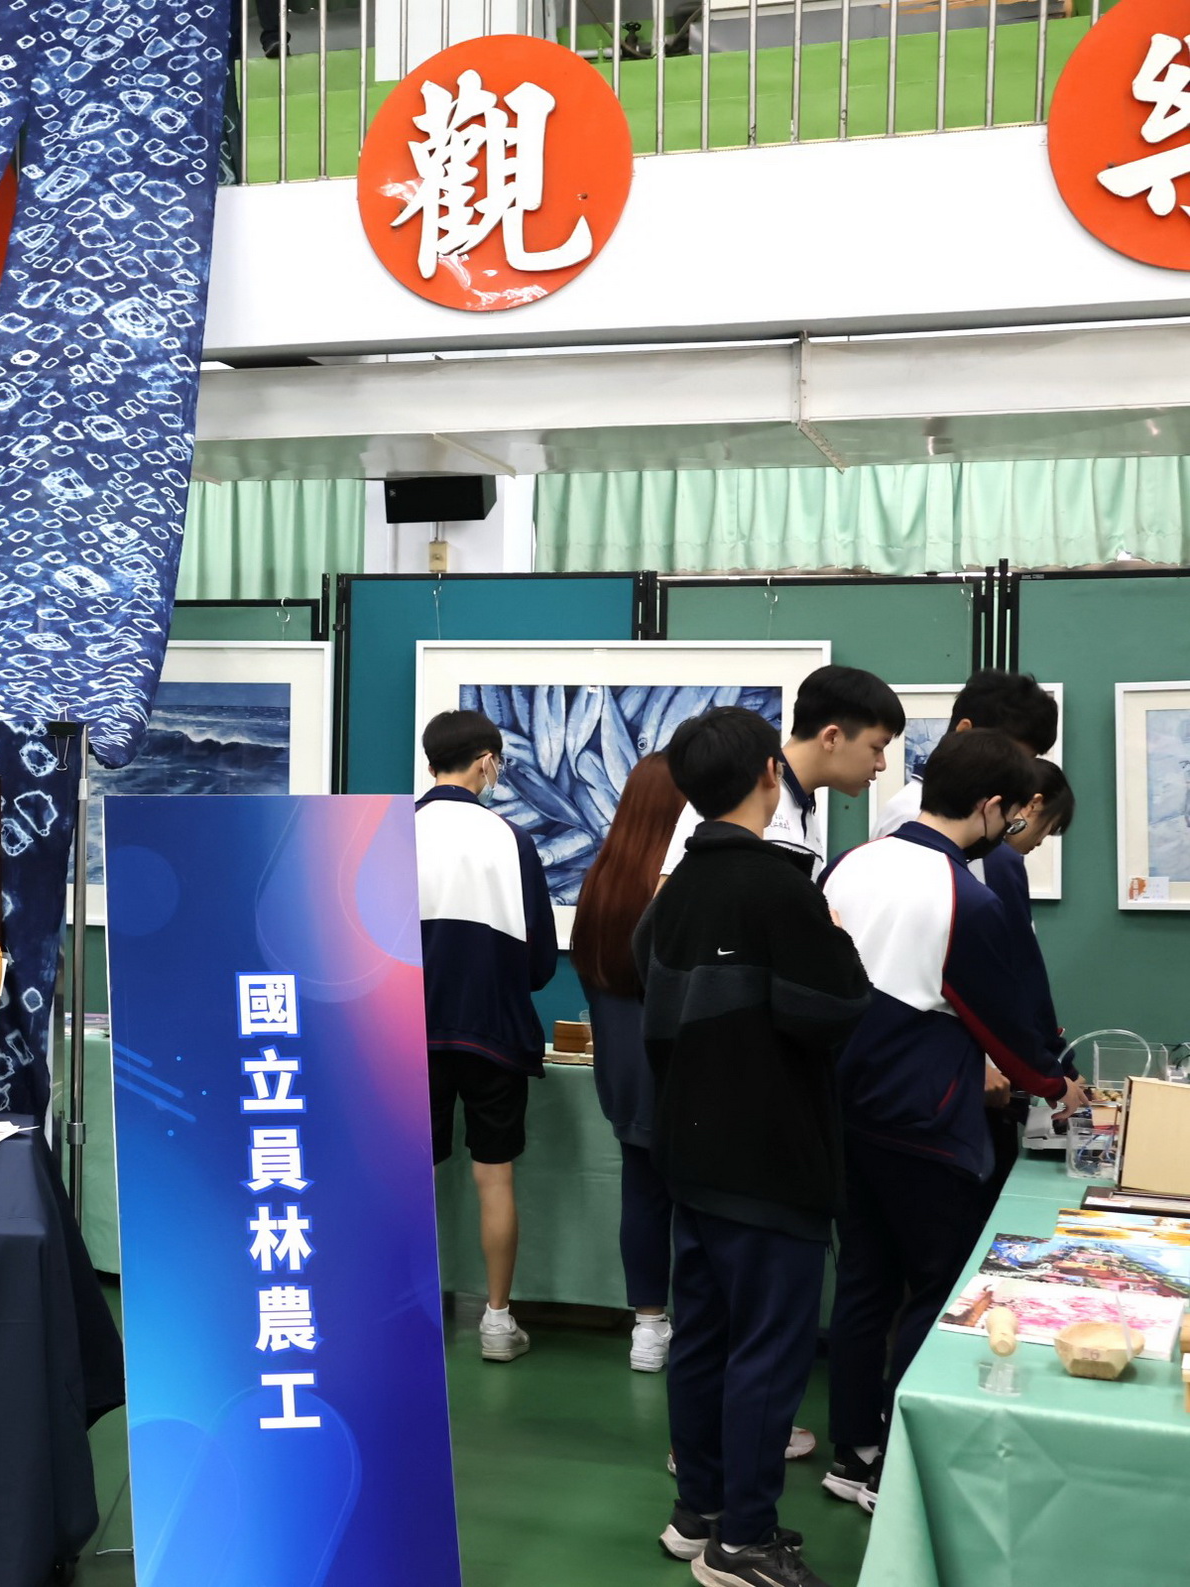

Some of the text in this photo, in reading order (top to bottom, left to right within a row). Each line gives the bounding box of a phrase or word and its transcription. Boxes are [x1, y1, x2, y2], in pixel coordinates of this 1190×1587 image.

[390, 69, 594, 279] 觀
[236, 973, 321, 1430] 國立員林農工
